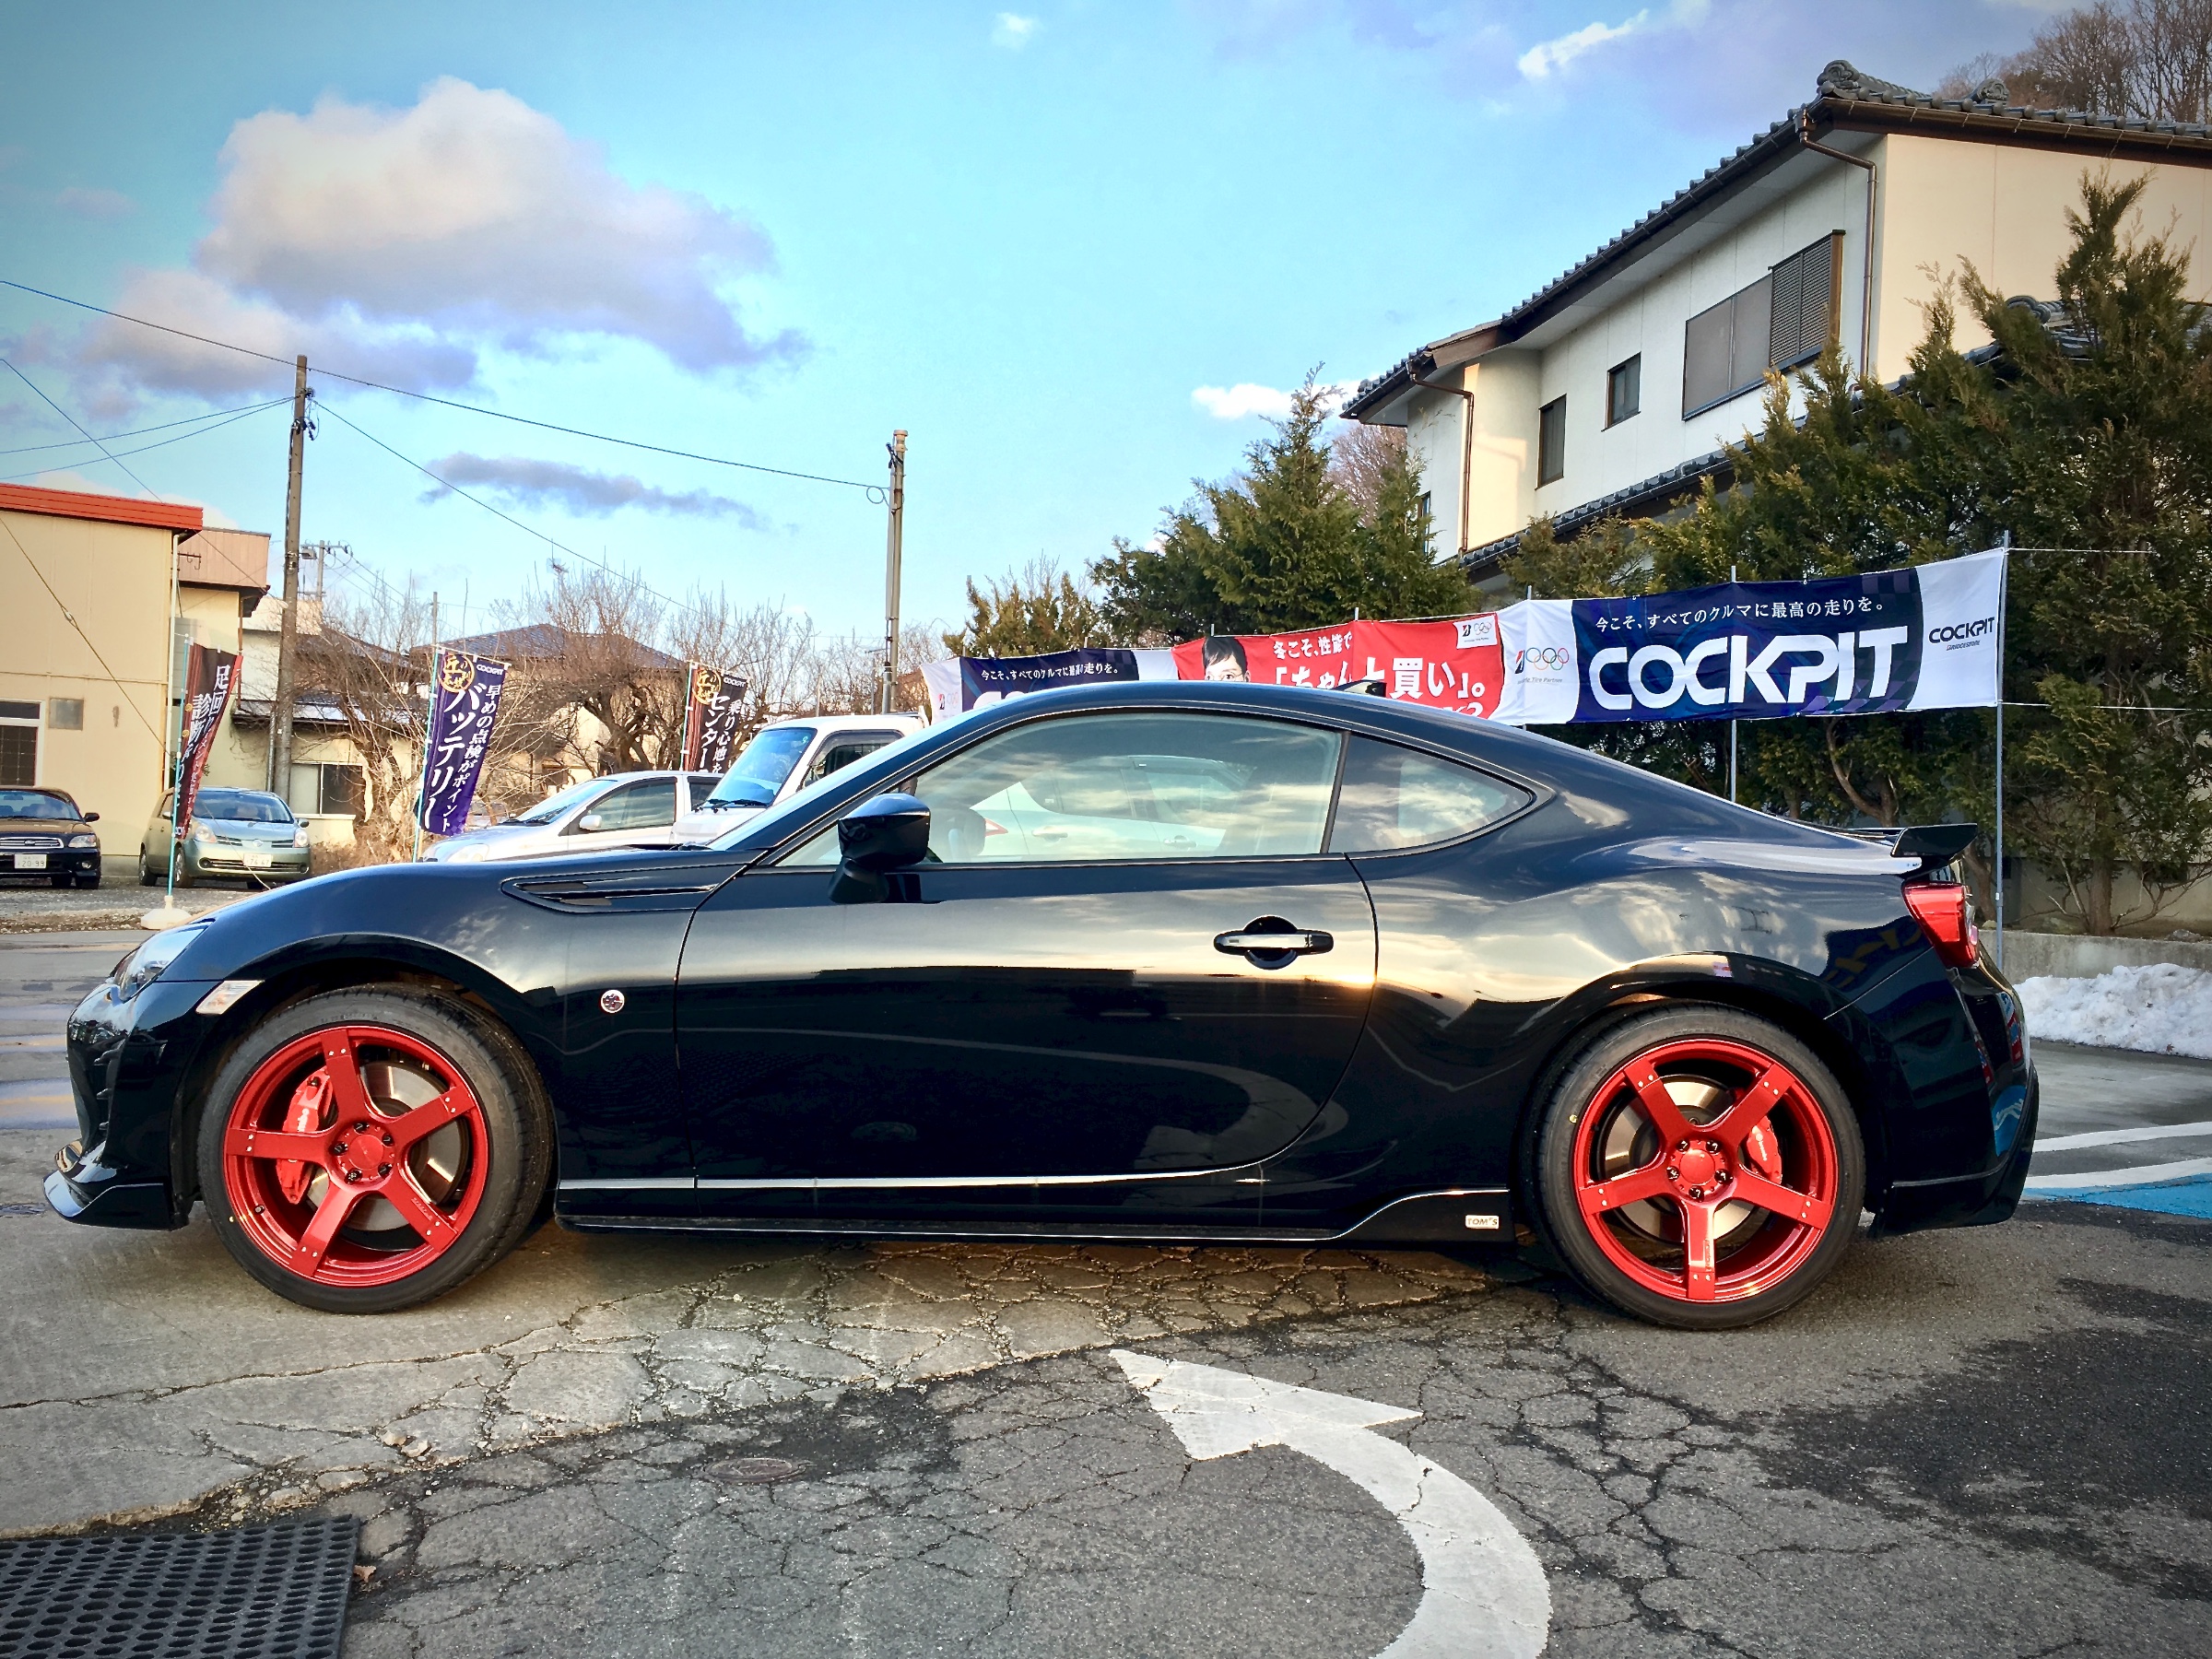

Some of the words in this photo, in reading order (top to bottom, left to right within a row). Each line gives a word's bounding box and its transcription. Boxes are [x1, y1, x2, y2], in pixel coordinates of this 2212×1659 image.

[1595, 596, 1883, 632] 今こそ、すべてのクルマに最高の走りを。
[1928, 617, 1994, 643] COCKPIT
[1589, 626, 1908, 710] COCKPIT
[424, 682, 487, 830] バッテリー
[442, 684, 501, 832] 早めの点検がポイント
[700, 691, 730, 772] センター
[1467, 1218, 1498, 1226] TOM'S
